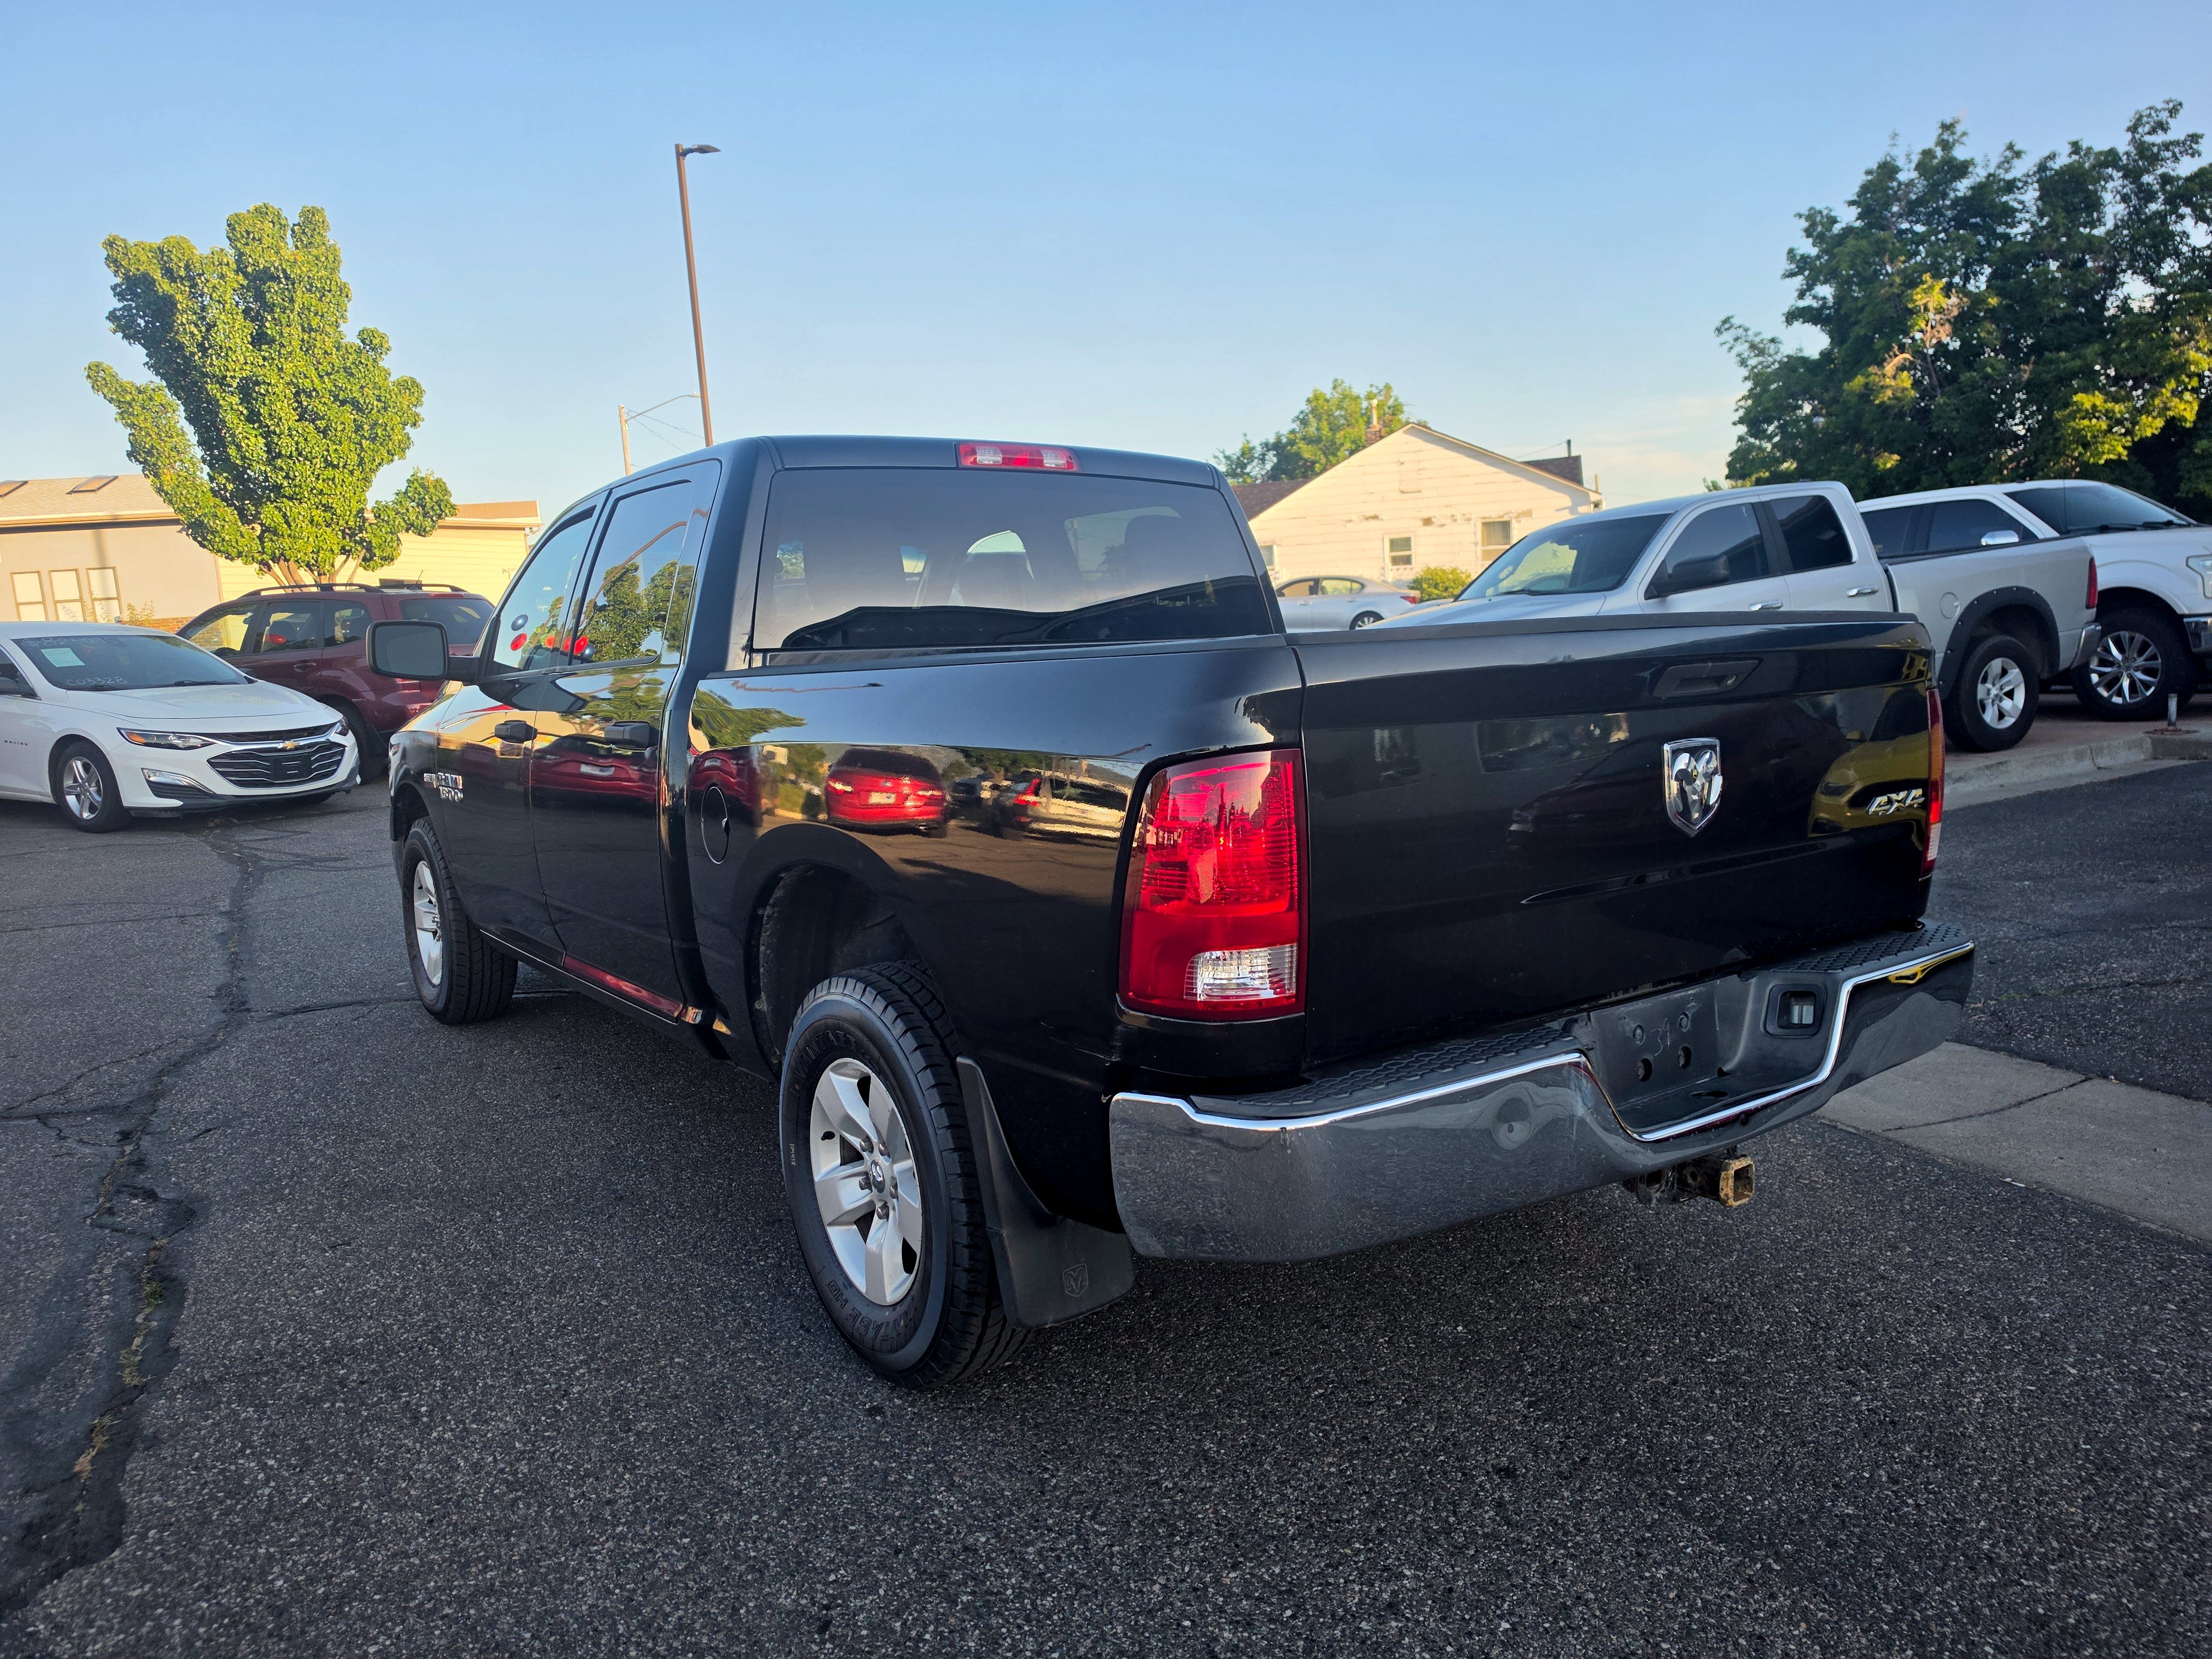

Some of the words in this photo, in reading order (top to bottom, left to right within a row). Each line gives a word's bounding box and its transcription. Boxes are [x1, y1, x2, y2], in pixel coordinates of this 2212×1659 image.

[436, 772, 463, 789] RAM
[439, 786, 463, 803] 1500
[826, 1279, 849, 1309] HD
